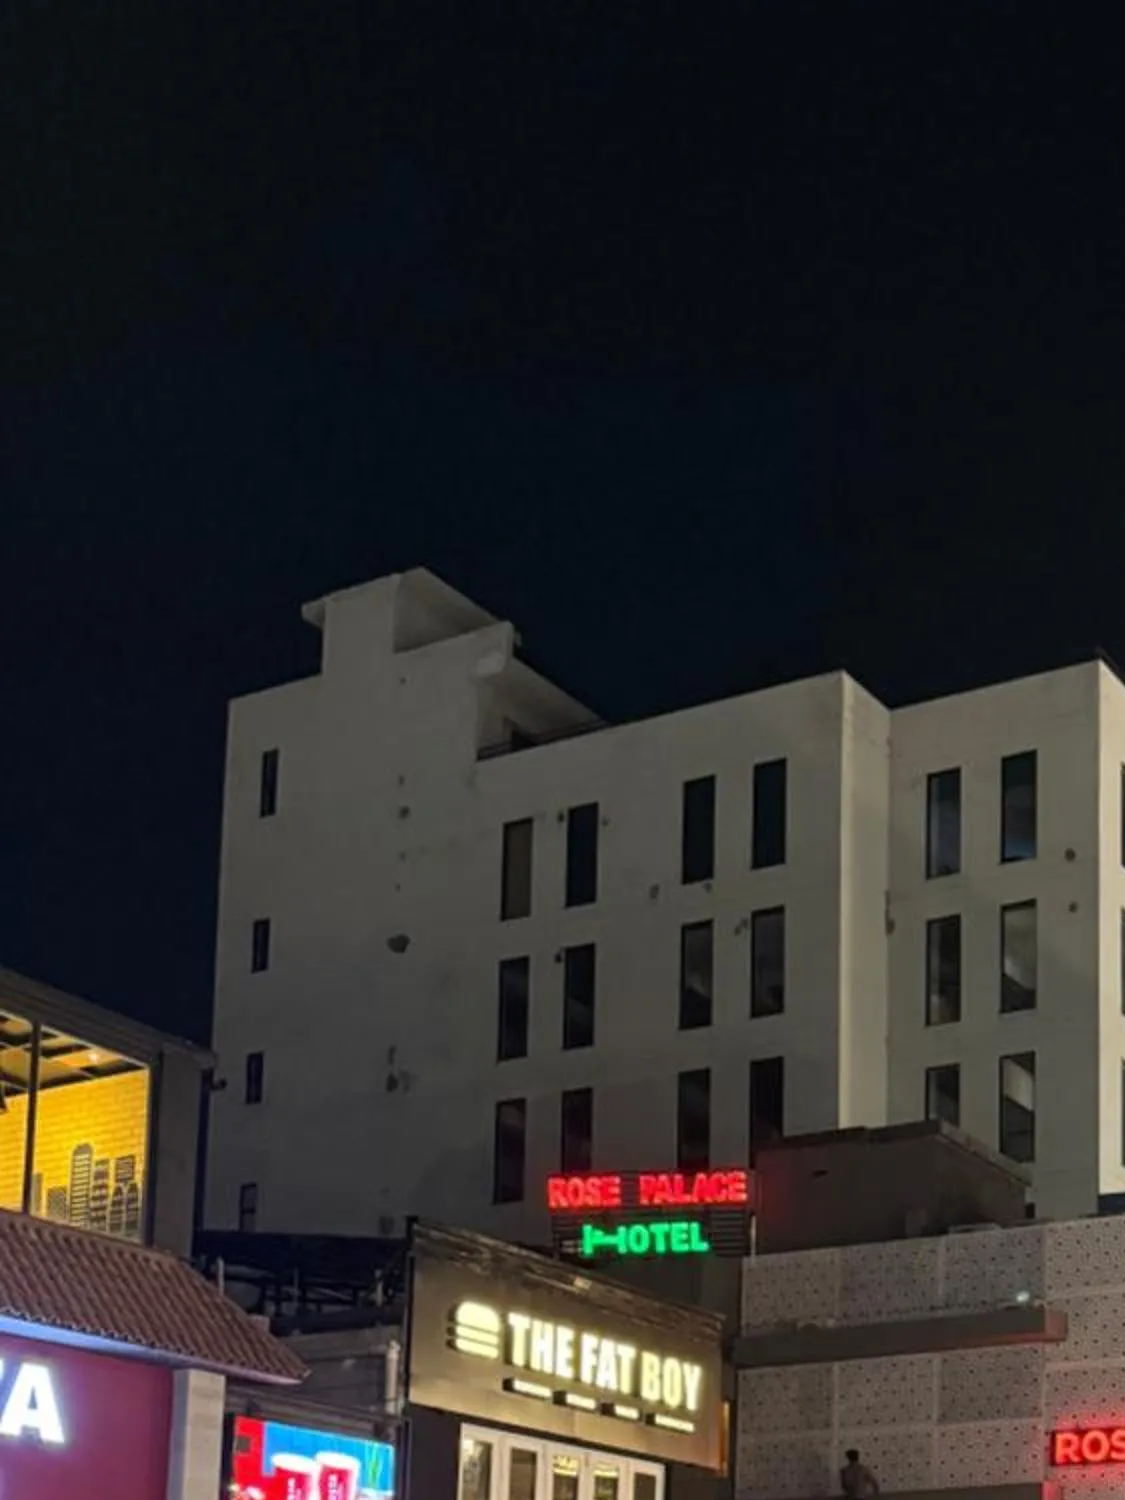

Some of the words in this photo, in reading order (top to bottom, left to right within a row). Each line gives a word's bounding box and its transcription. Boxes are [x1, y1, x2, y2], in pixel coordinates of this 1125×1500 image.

[548, 1176, 621, 1208] ROSE
[639, 1171, 748, 1205] PALACE
[582, 1221, 709, 1254] HOTEL
[507, 1312, 576, 1379] THE
[579, 1332, 637, 1395] FAT
[640, 1350, 703, 1412] BOY
[0, 1359, 65, 1443] A
